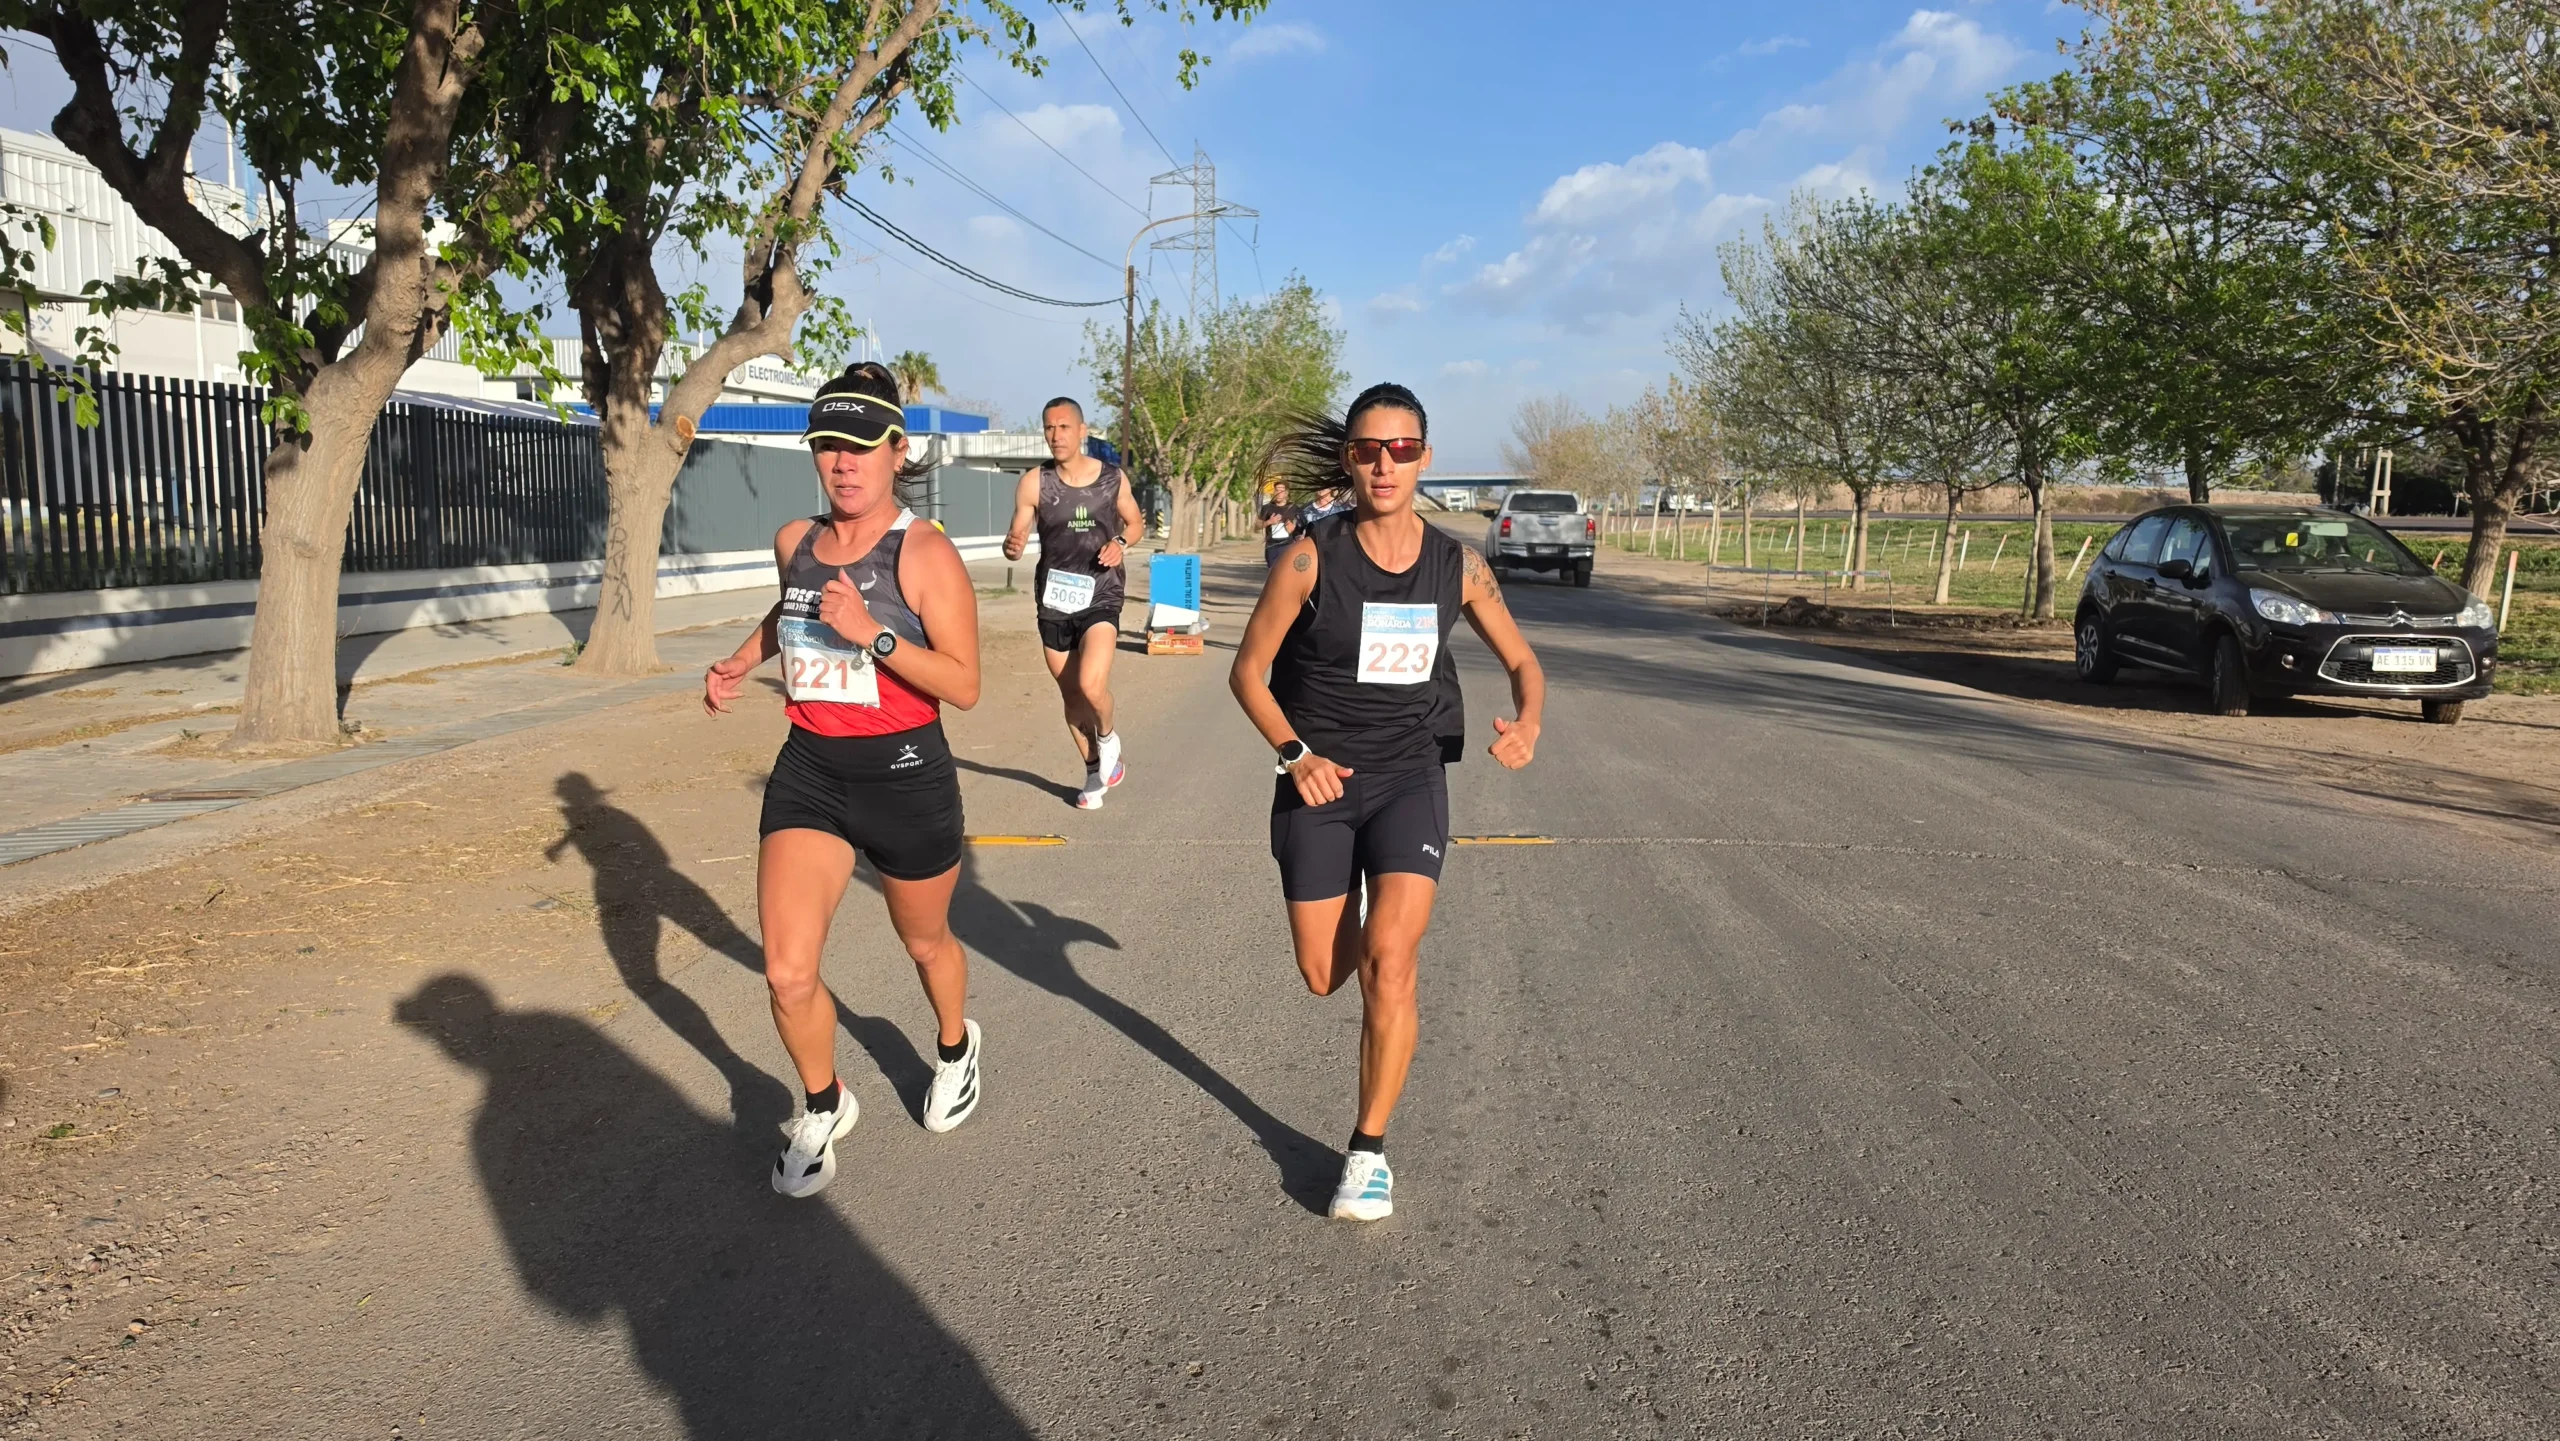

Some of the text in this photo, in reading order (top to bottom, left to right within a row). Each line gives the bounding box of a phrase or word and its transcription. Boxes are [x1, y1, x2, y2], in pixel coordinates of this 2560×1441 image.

[1067, 519, 1096, 528] ANIMAL
[1050, 586, 1087, 606] 5063
[1366, 619, 1411, 629] BONARDA
[1365, 642, 1430, 673] 223
[2376, 655, 2433, 666] AE 115 VK
[790, 656, 848, 690] 221
[890, 759, 924, 770] GYSPORT
[1422, 843, 1440, 859] FILA
